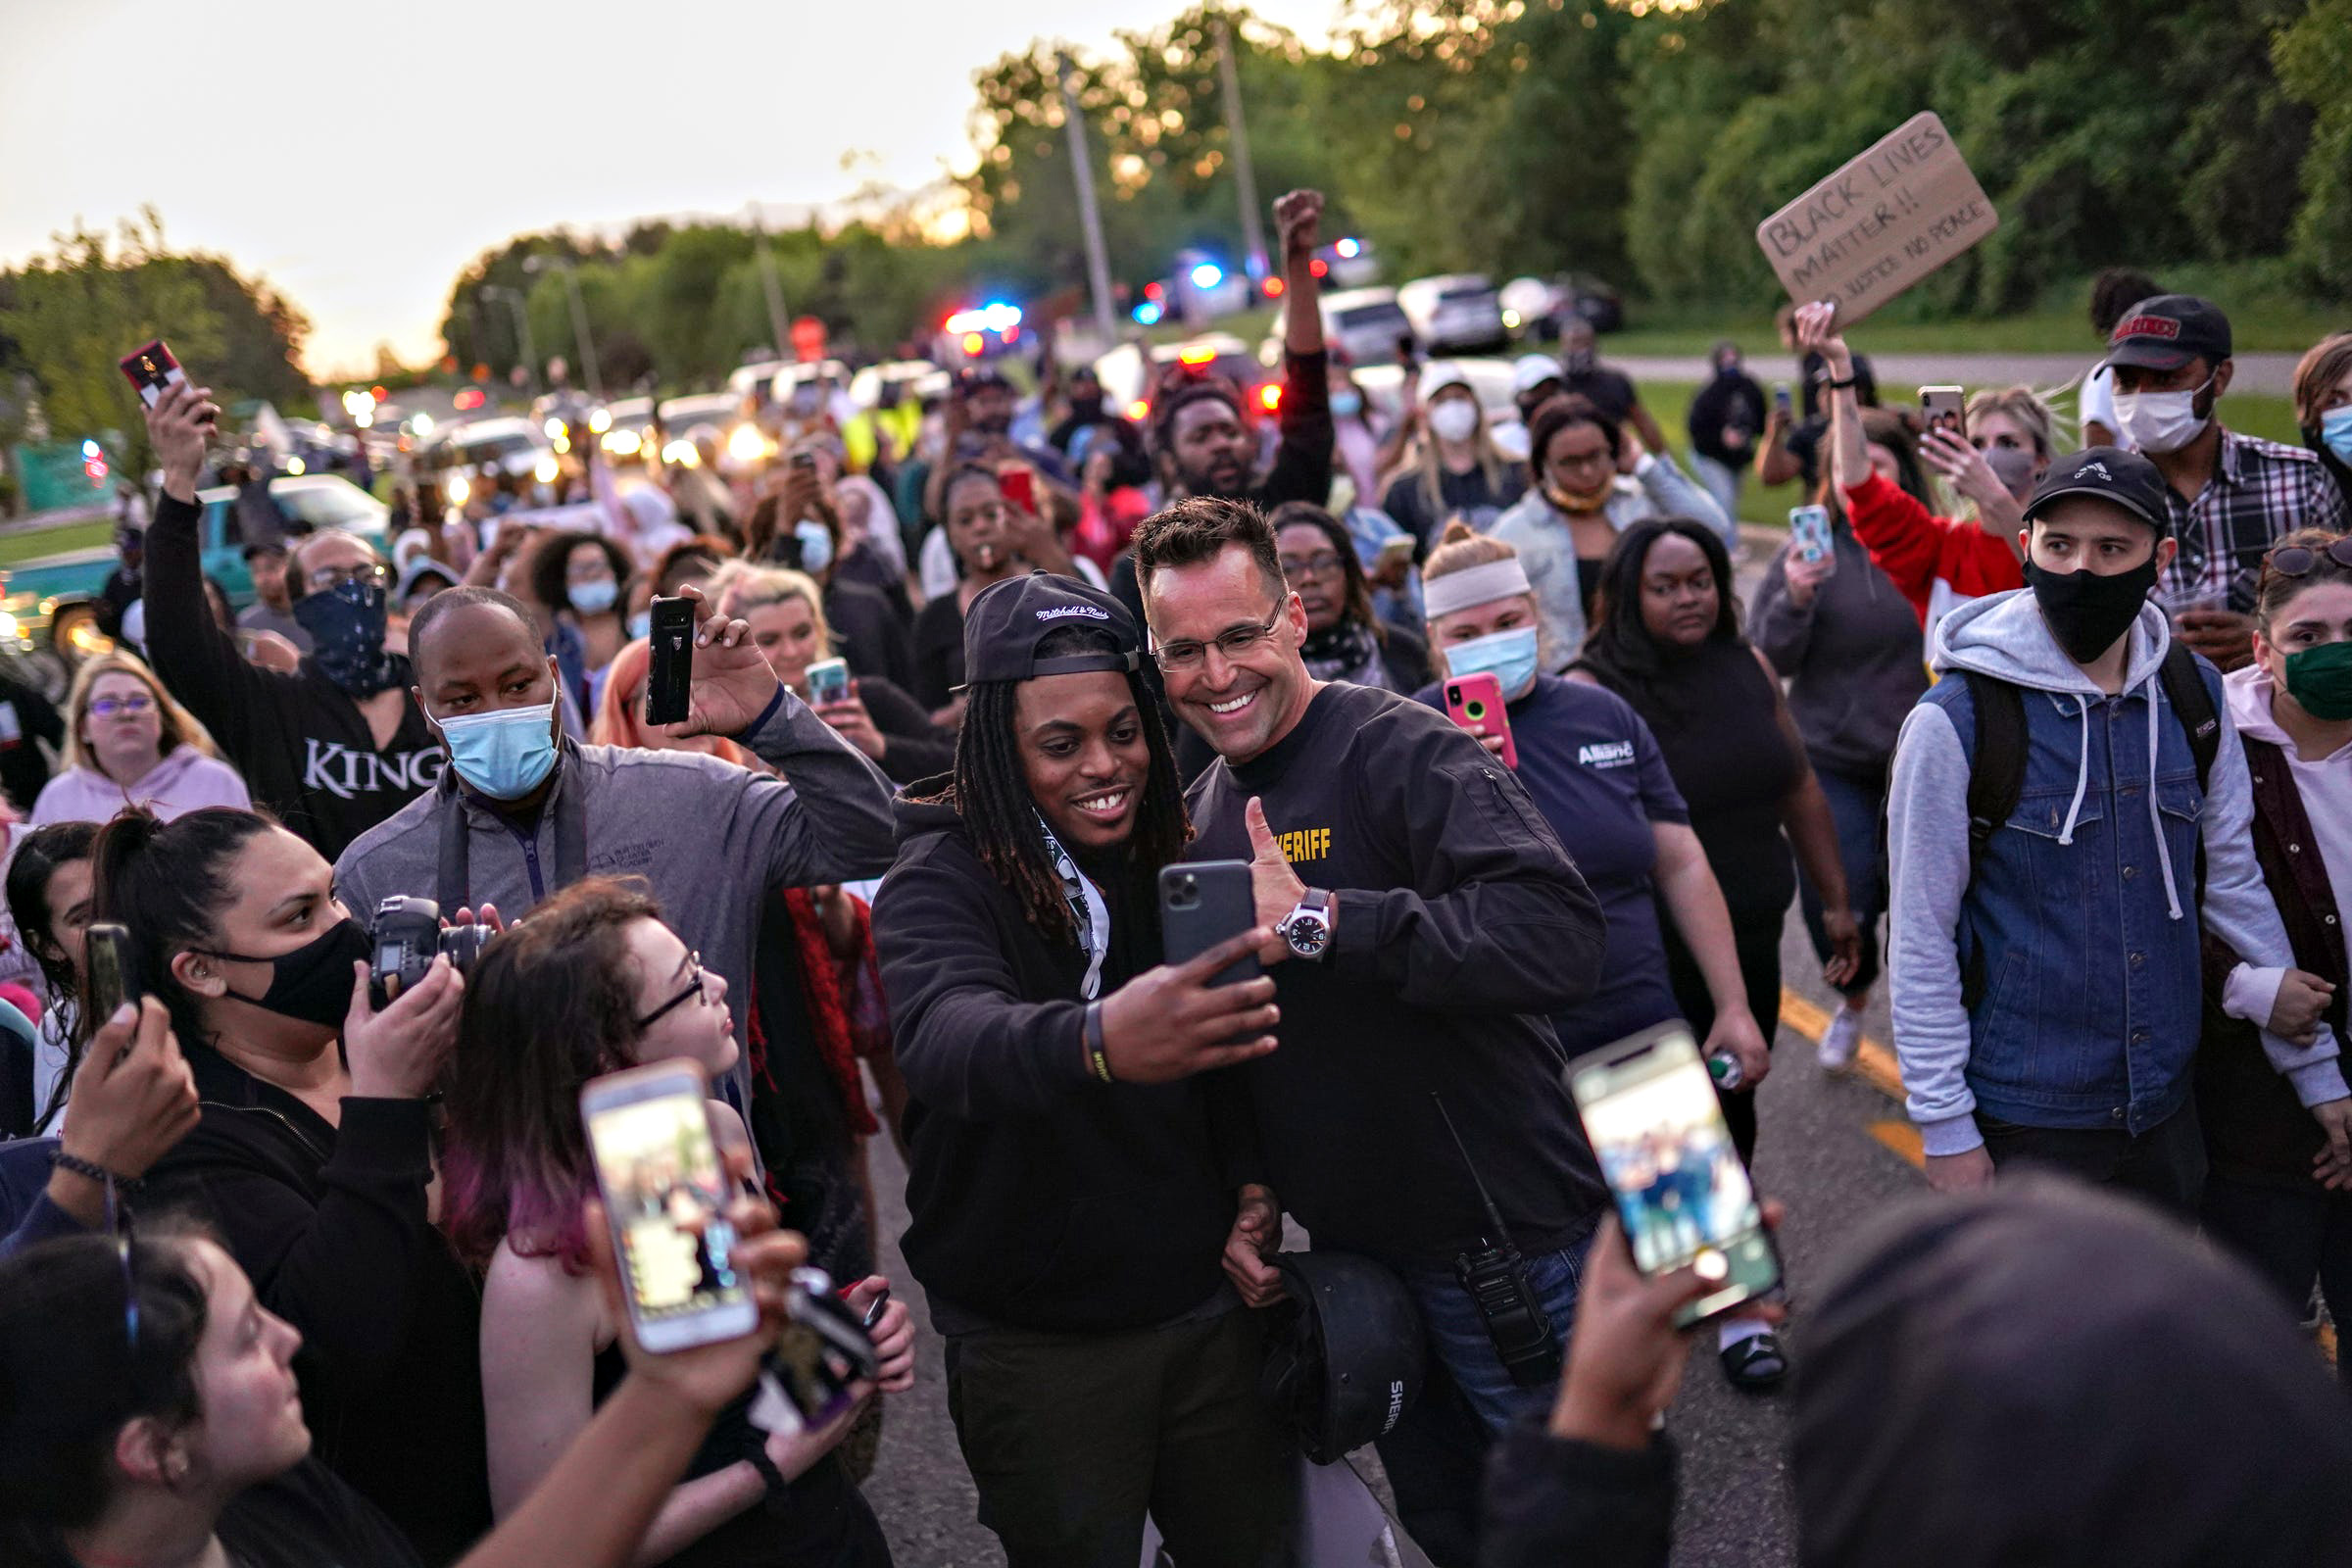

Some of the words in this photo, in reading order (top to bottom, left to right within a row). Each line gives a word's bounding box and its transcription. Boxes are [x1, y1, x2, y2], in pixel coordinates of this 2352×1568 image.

[1768, 176, 1864, 257] BLACK
[1866, 125, 1945, 189] LIVES
[1904, 235, 1931, 259] NO
[1930, 200, 1986, 244] PEACE
[1036, 605, 1080, 620] Mitchell
[302, 736, 447, 800] KING
